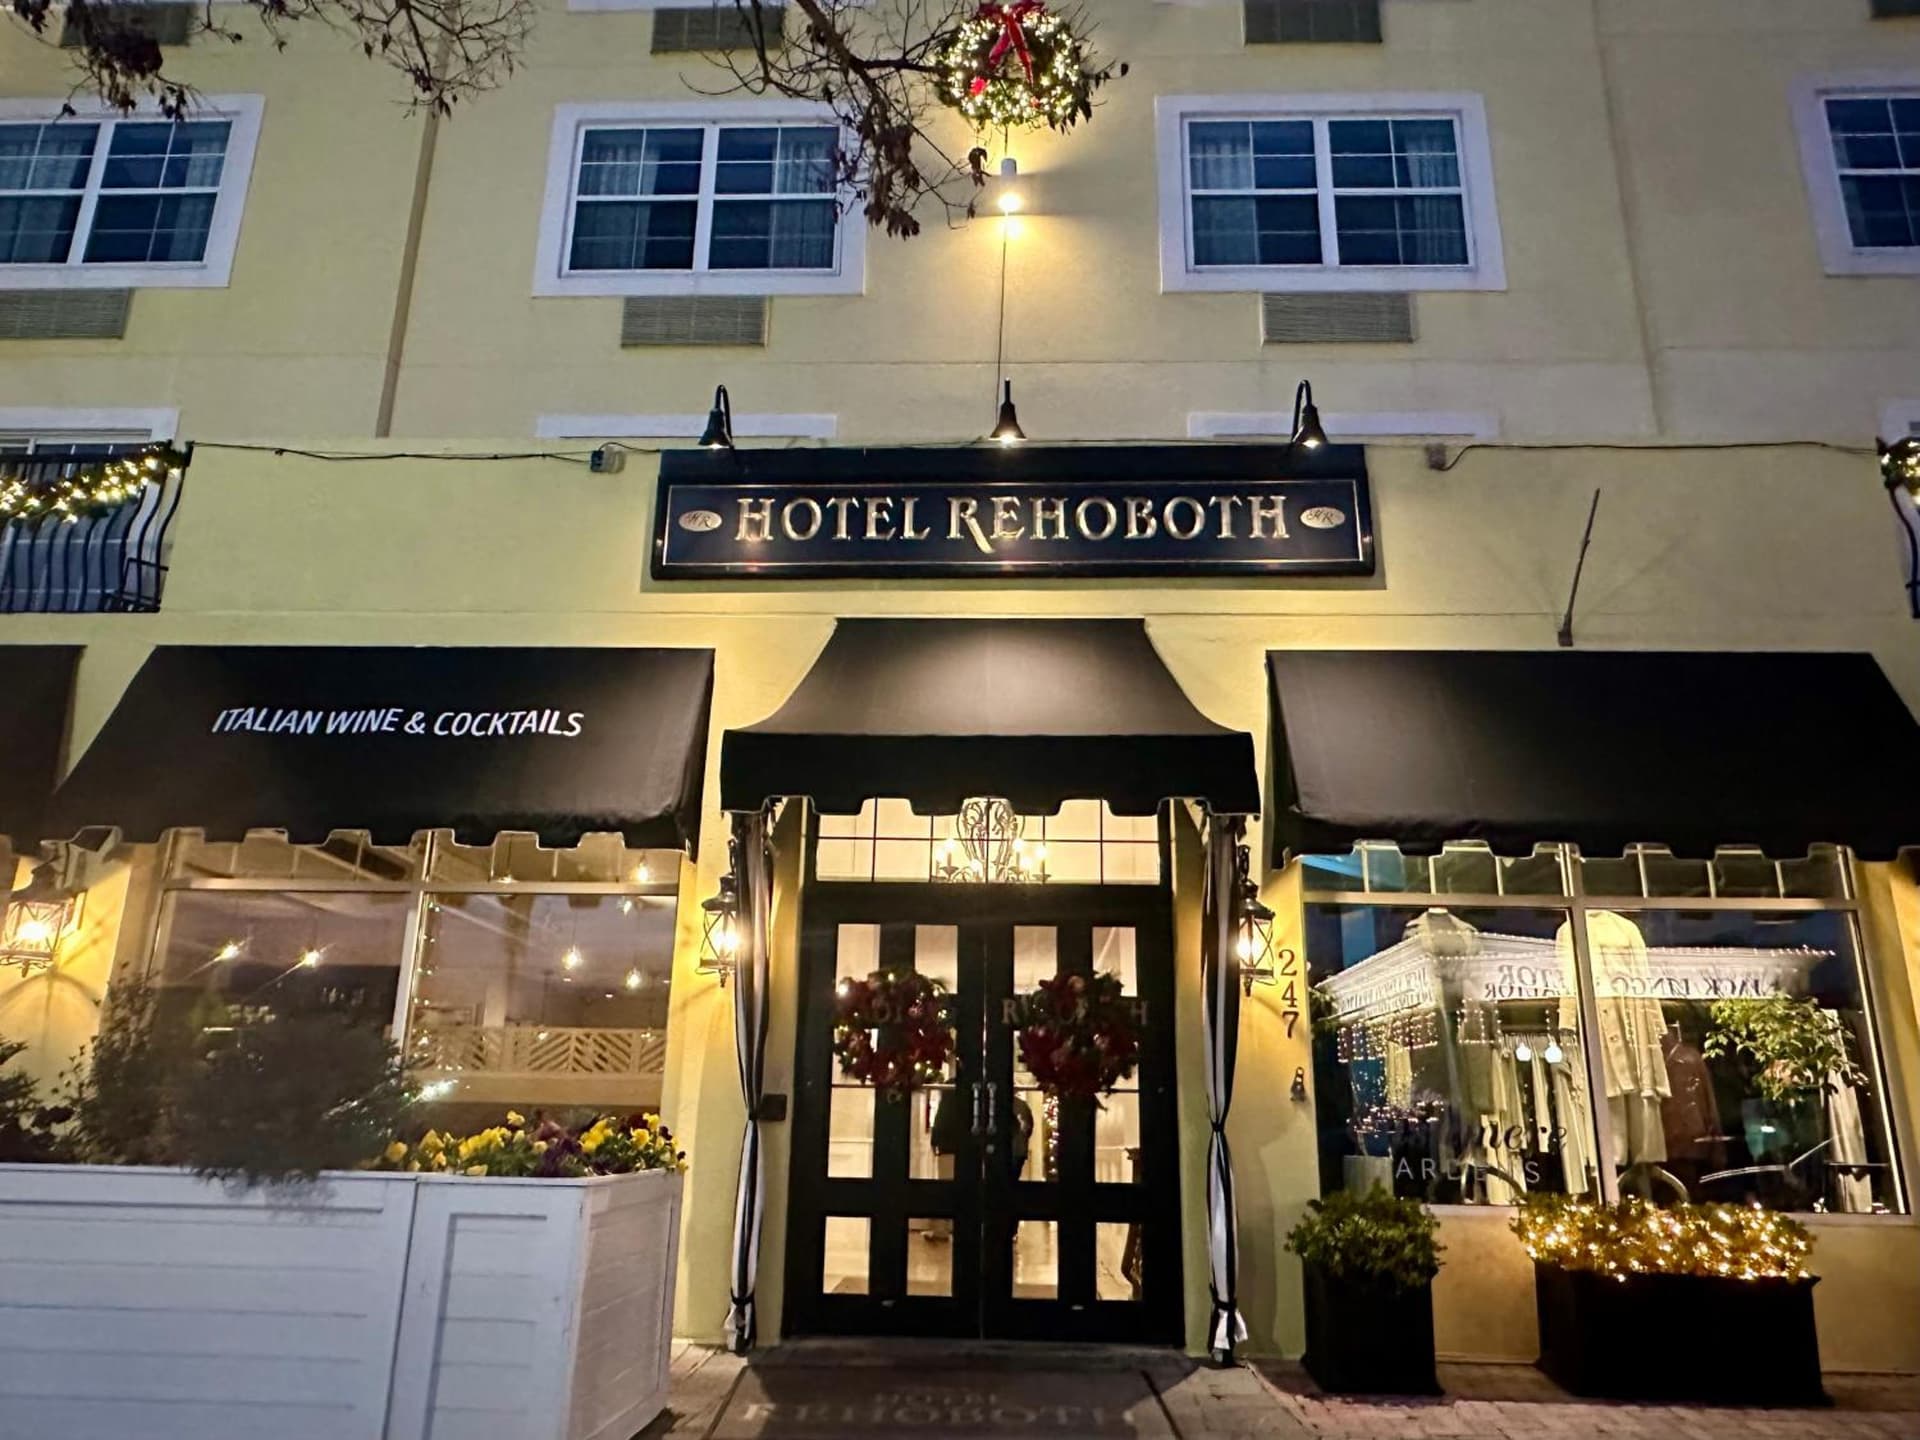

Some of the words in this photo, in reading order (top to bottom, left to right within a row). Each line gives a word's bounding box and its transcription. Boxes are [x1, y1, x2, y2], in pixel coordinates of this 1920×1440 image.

[734, 497, 931, 541] HOTEL
[946, 495, 1290, 554] REHOBOTH
[212, 707, 323, 734] ITALIAN
[325, 708, 404, 733] WINE
[404, 711, 426, 734] &
[433, 709, 584, 737] COCKTAILS
[1279, 949, 1299, 1038] 247
